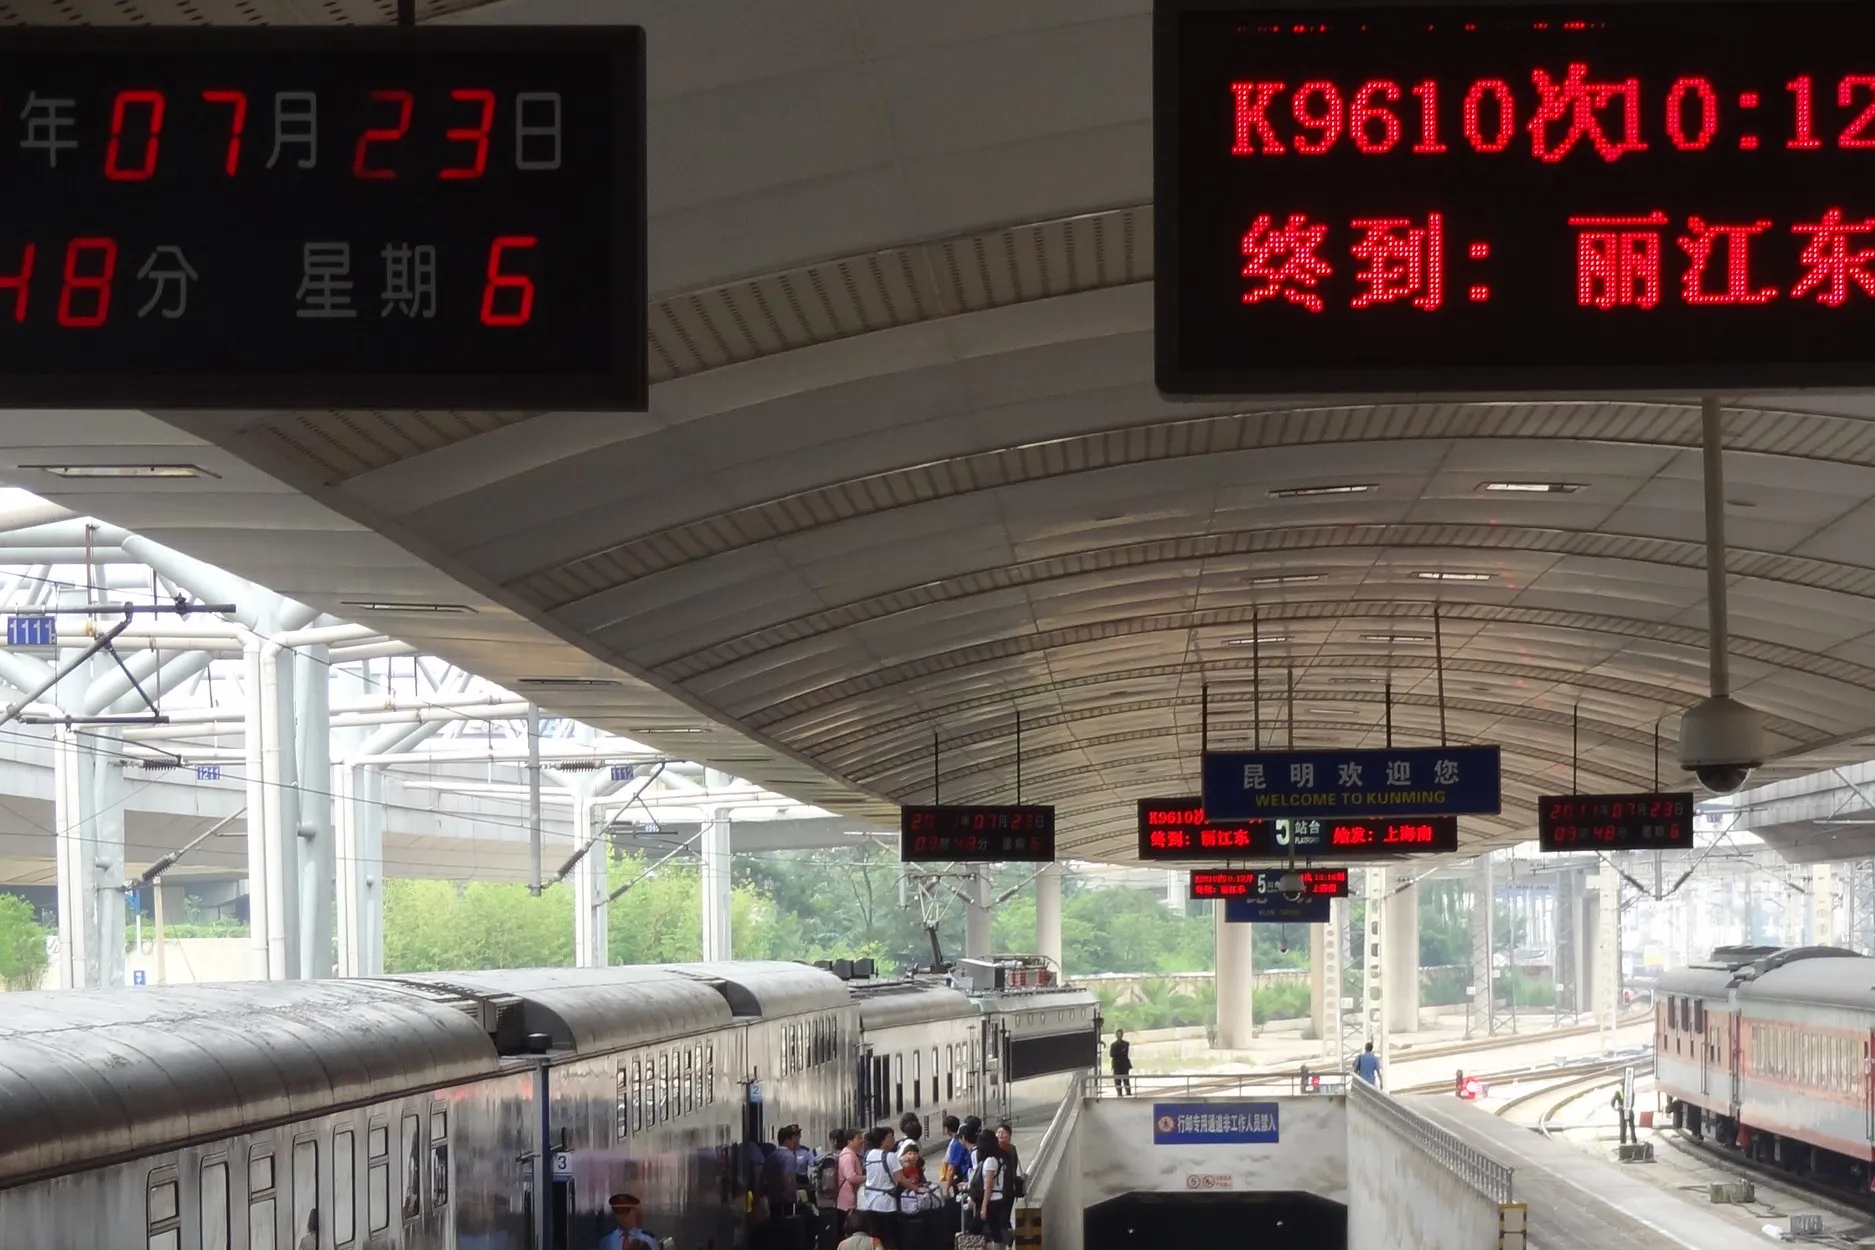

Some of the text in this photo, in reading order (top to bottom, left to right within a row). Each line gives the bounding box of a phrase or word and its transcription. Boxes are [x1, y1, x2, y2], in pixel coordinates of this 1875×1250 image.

[9, 619, 53, 644] 1111
[1243, 759, 1460, 790] 昆明欢迎您
[1255, 790, 1446, 807] WELCOME TO KUNMING
[1294, 820, 1321, 835] 站台
[1257, 874, 1266, 894] 5
[752, 1086, 760, 1095] 2
[557, 1155, 567, 1170] 3
